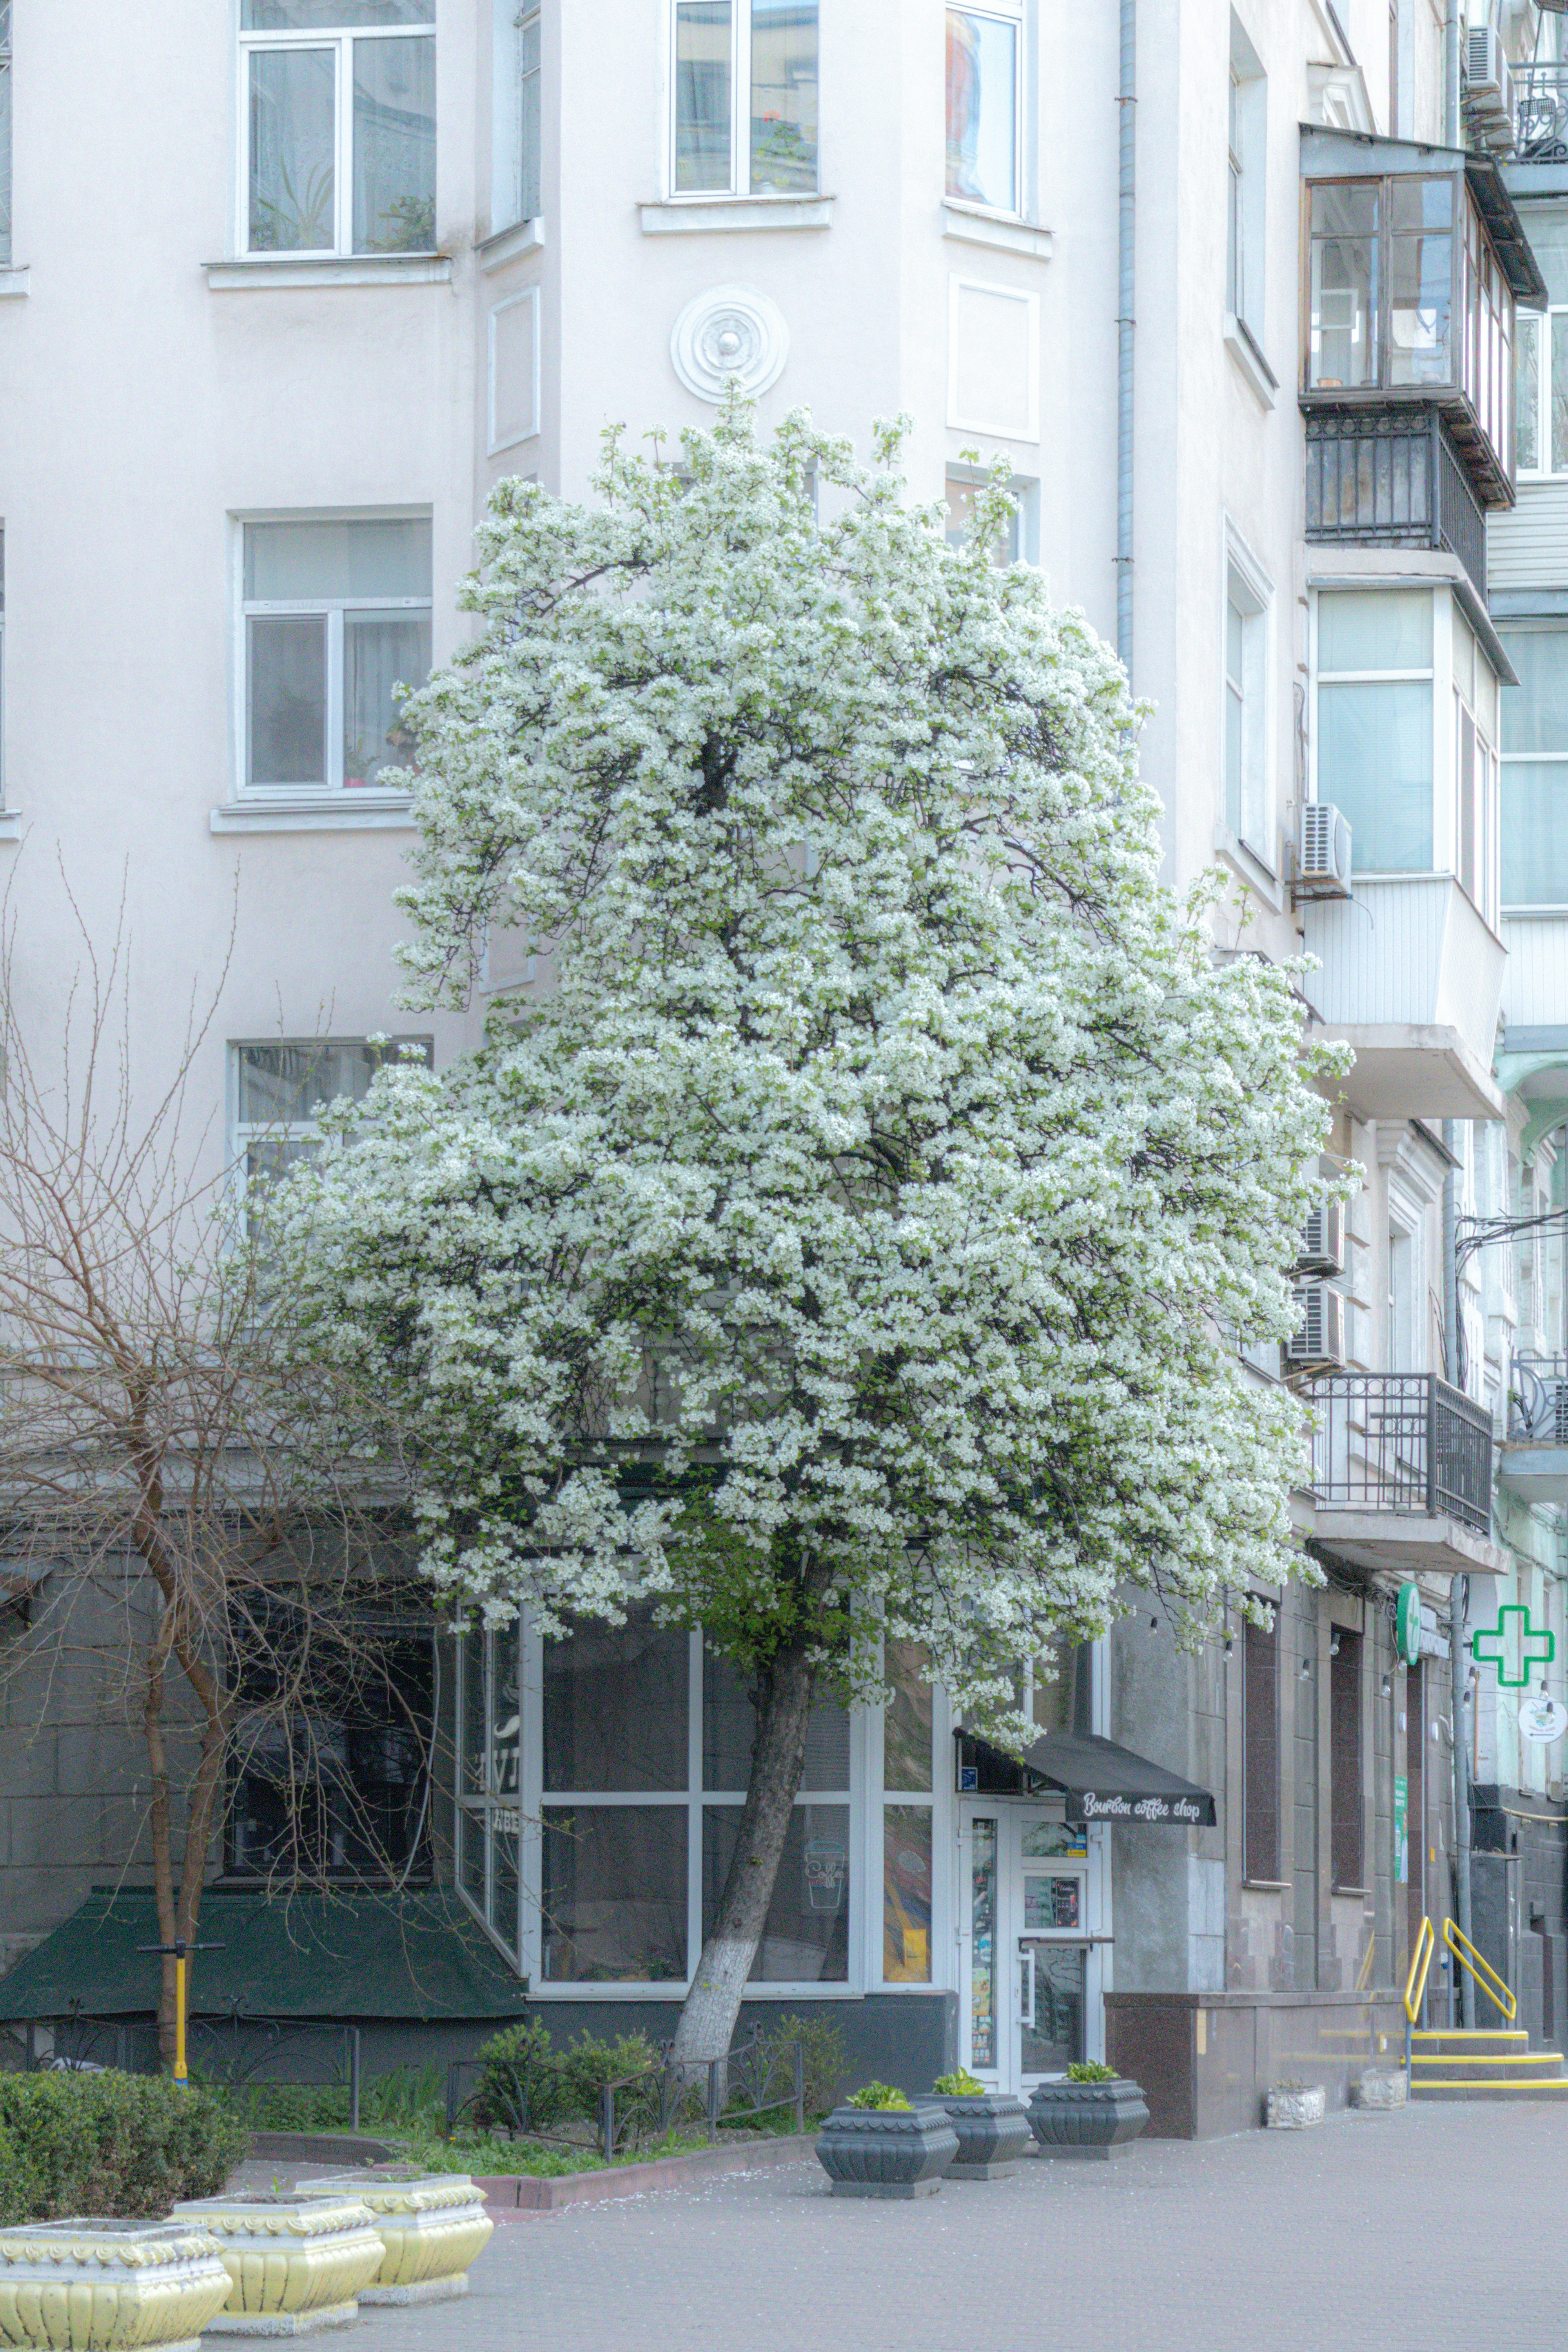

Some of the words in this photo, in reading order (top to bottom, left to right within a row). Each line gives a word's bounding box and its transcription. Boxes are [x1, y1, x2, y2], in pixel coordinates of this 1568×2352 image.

[1084, 1792, 1131, 1817] Bourbon
[1135, 1798, 1169, 1820] coffee
[1174, 1797, 1200, 1822] shop
